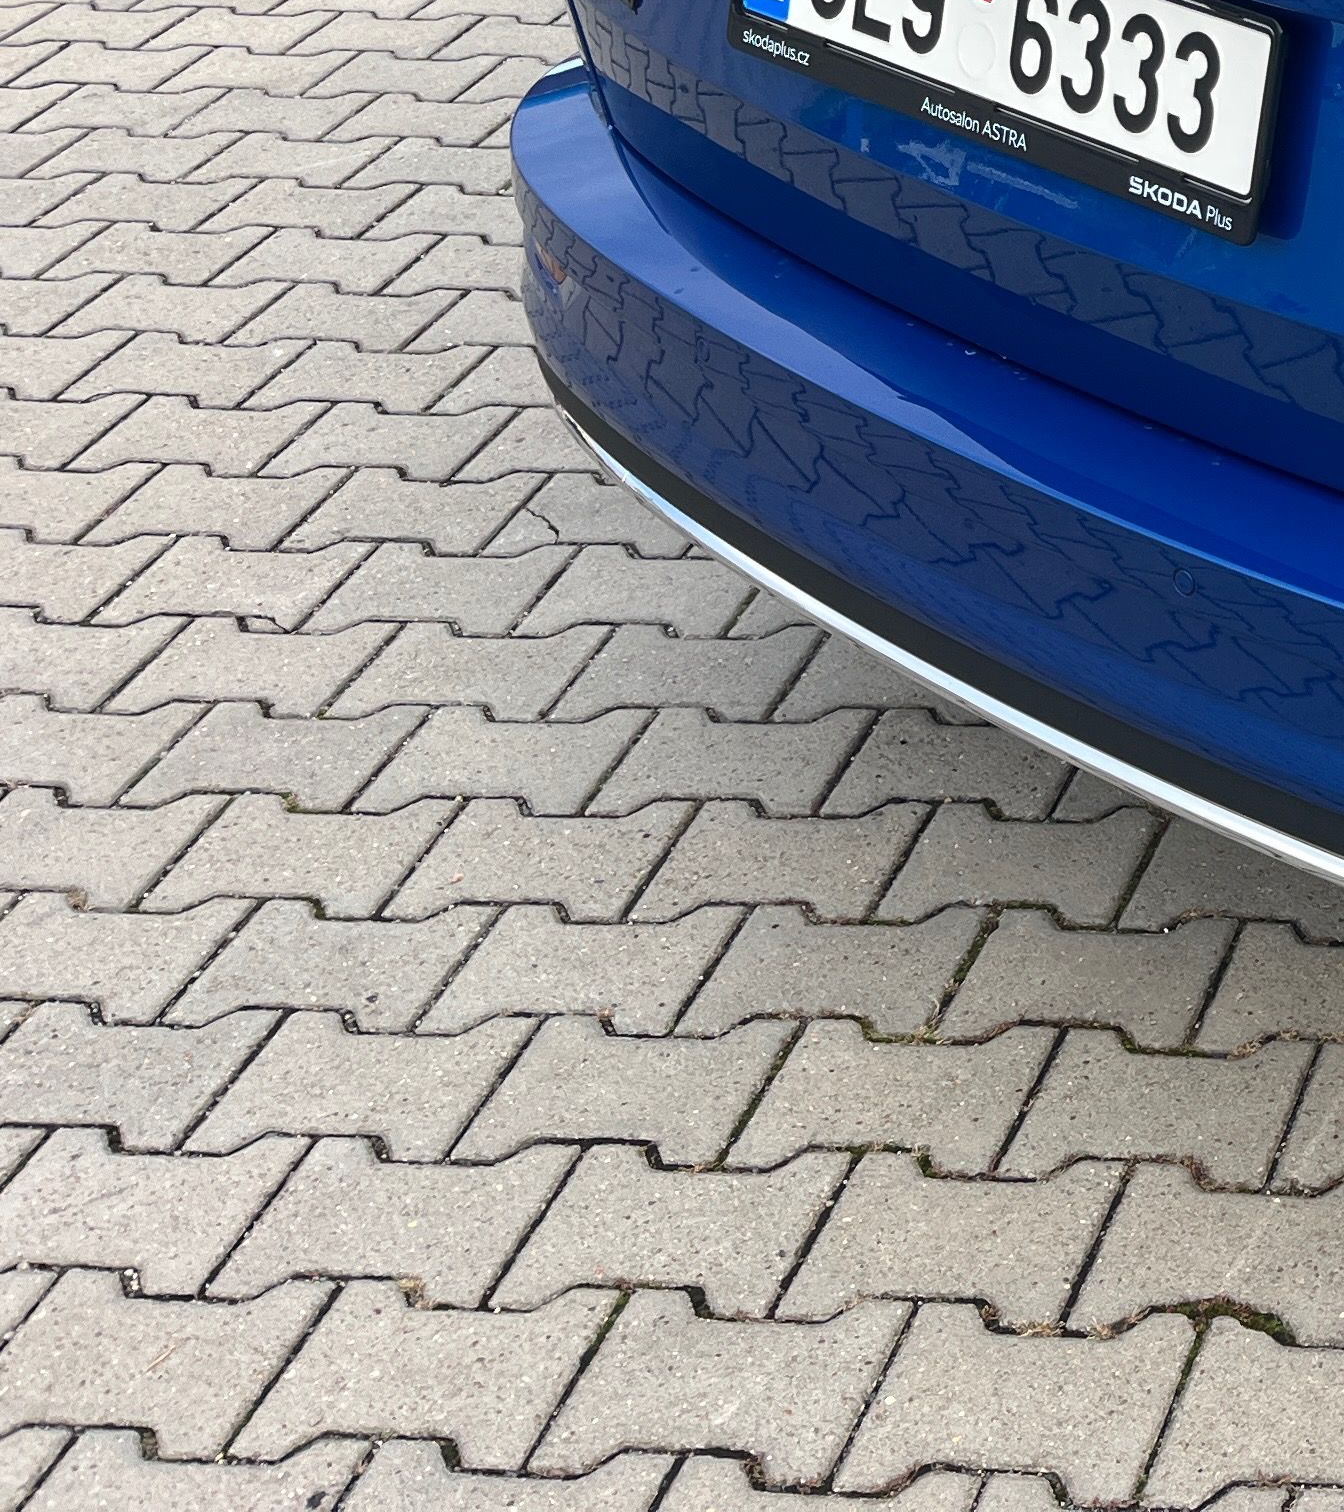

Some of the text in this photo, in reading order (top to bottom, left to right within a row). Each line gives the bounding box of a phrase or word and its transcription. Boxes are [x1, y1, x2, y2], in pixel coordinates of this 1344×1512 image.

[742, 29, 811, 68] skodaplus.cz
[921, 96, 1028, 152] Autosalon ASTRA
[1128, 175, 1233, 231] SKODA Plus
